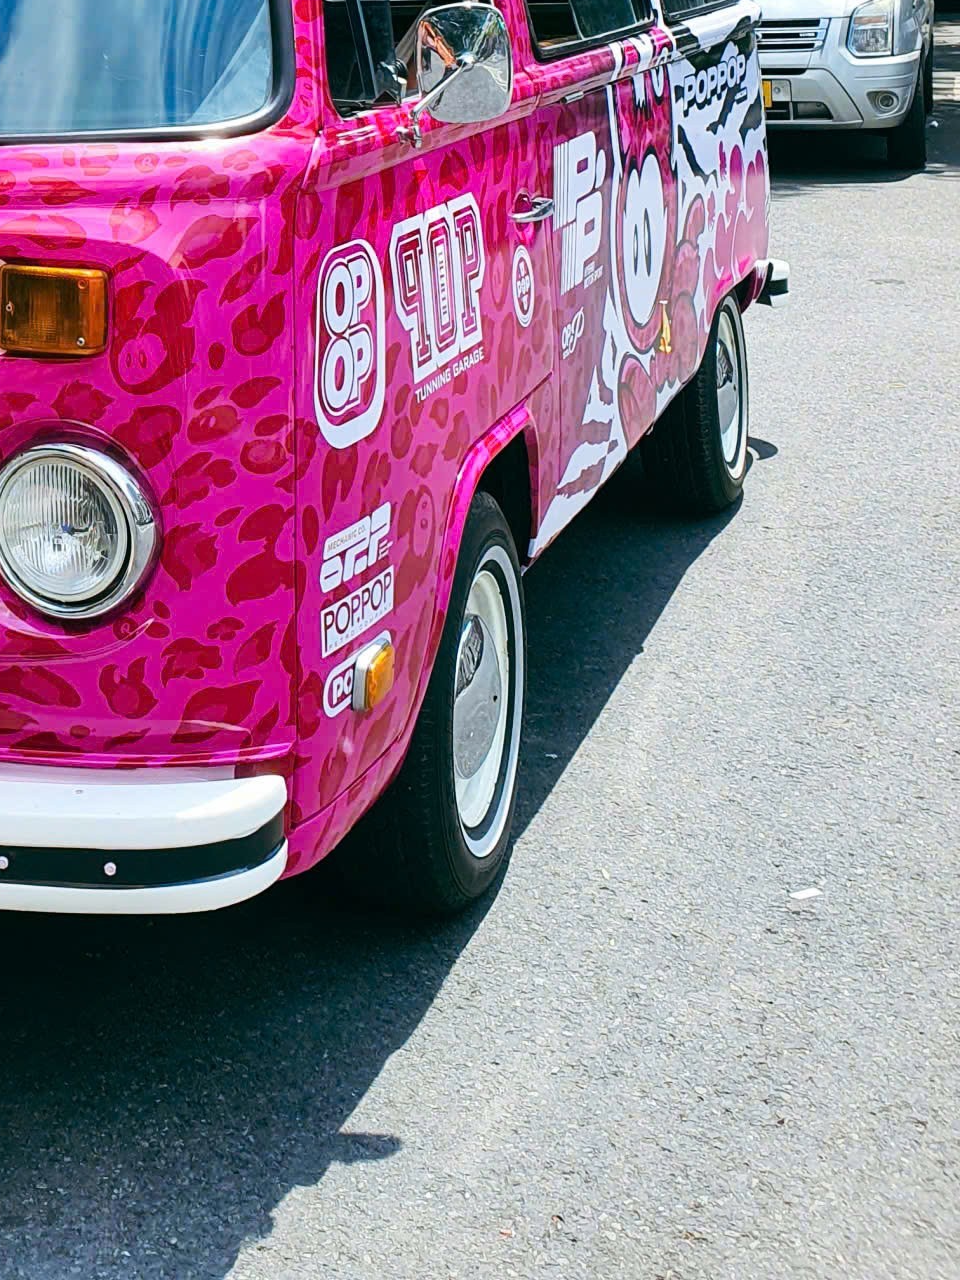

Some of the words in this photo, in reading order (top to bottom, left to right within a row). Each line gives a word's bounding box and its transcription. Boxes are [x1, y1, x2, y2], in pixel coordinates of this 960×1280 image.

[683, 54, 746, 114] POPPOP
[323, 252, 373, 336] OP
[321, 327, 373, 416] OP
[414, 368, 452, 404] TUNNING
[453, 346, 486, 378] GARAGE
